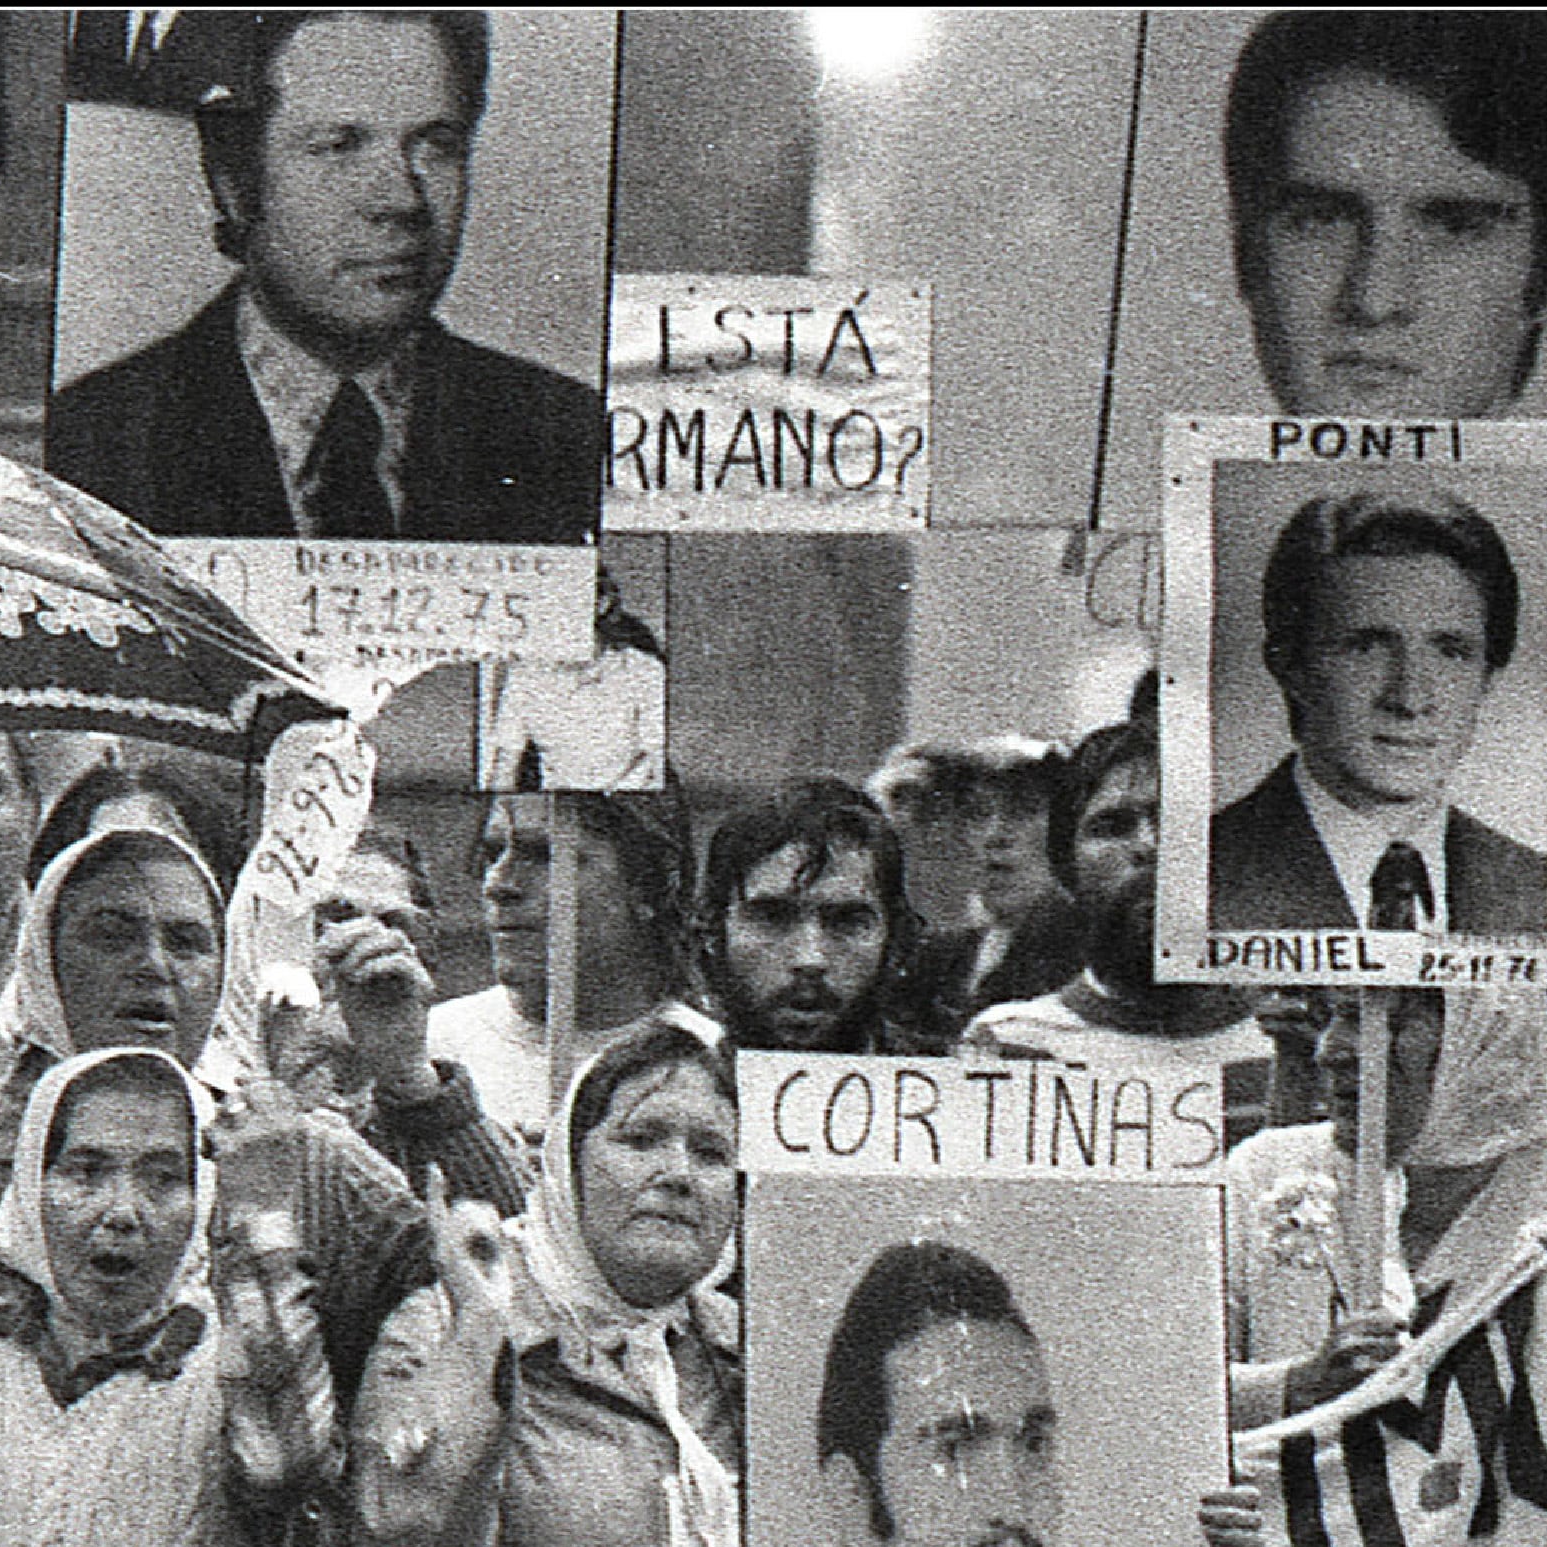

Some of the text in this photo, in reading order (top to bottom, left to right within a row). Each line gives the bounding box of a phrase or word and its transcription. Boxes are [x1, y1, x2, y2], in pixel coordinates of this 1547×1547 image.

[605, 407, 924, 496] RMANO?
[1270, 421, 1464, 461] PONTI
[1206, 935, 1386, 973] DANIEL
[773, 1056, 1220, 1171] CORTIÑAS
